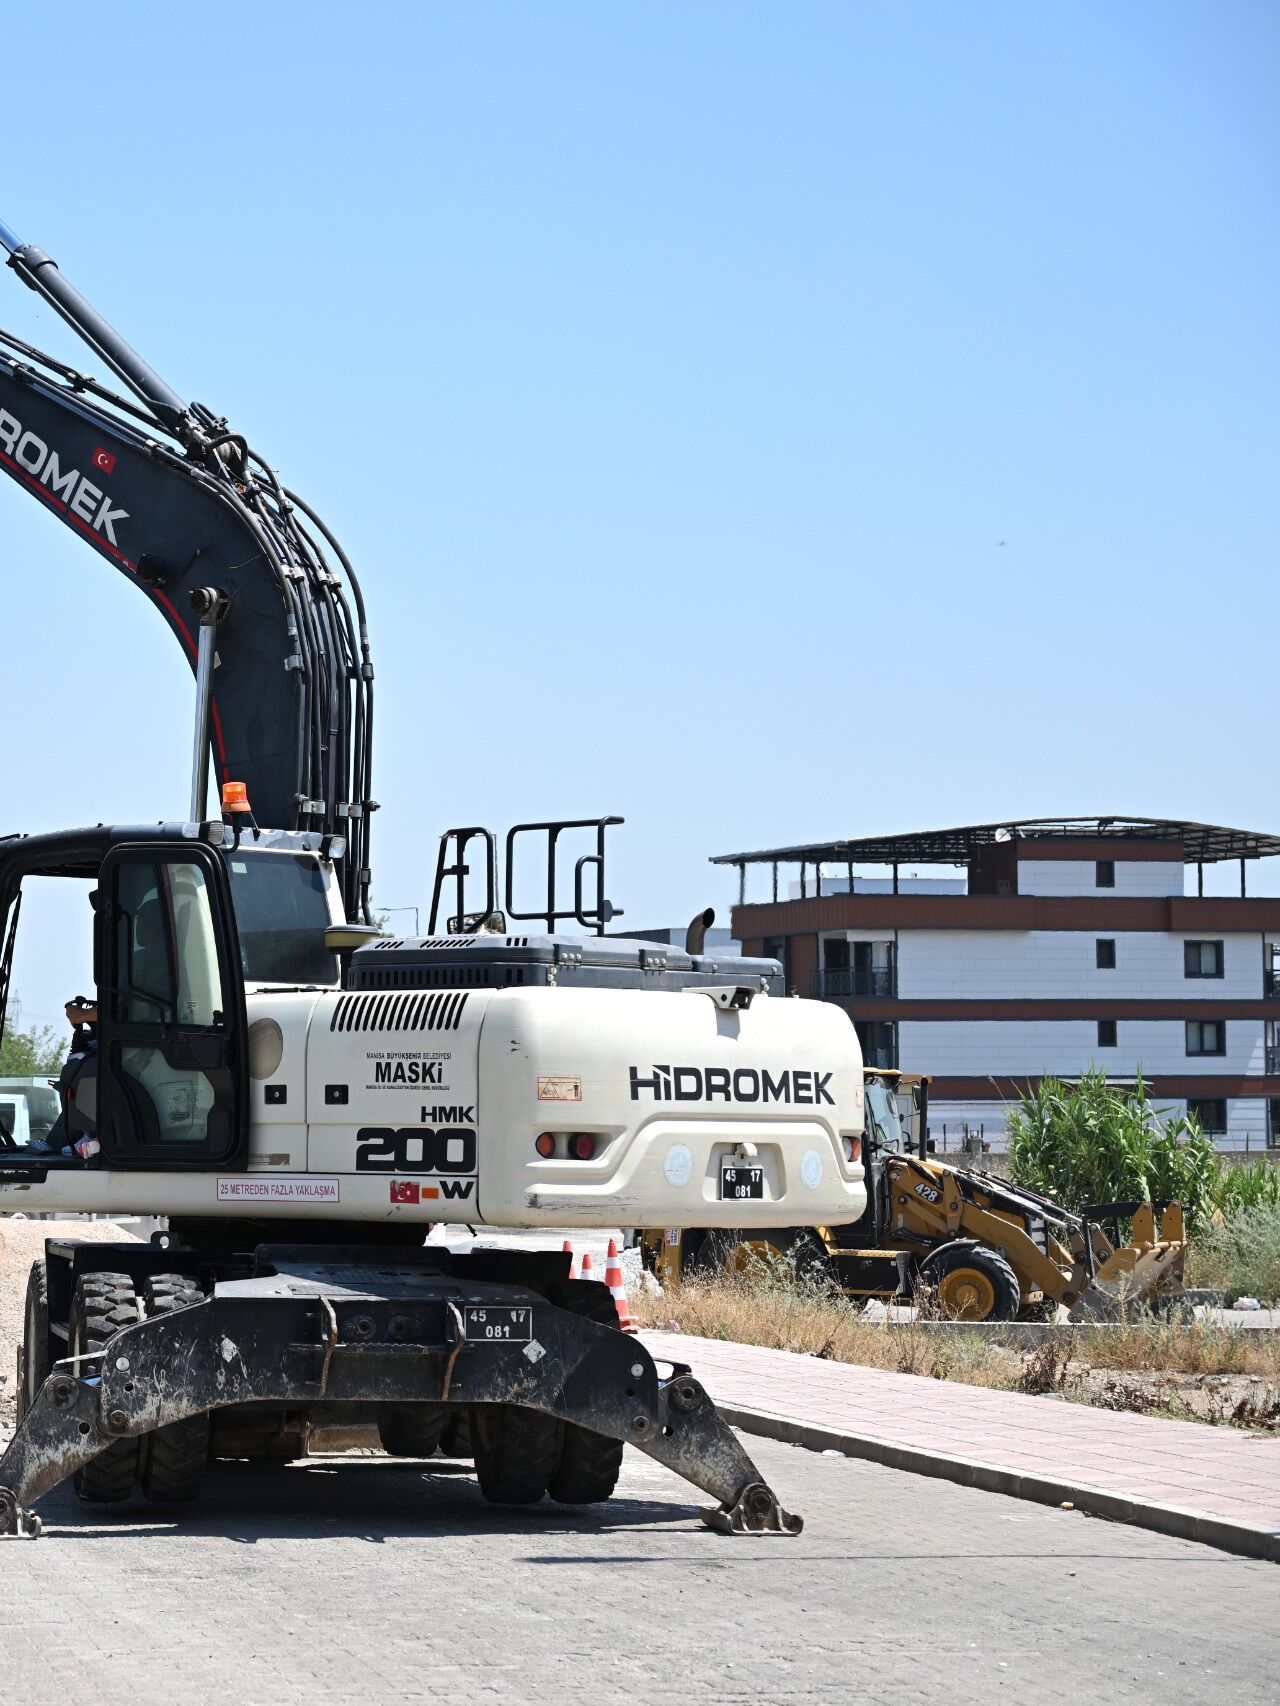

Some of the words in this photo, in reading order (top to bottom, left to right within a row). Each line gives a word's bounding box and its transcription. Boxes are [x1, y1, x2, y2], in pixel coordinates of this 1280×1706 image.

[421, 1105, 475, 1123] HMK
[355, 1127, 476, 1173] 200
[725, 1169, 736, 1182] 45
[750, 1169, 761, 1182] 17
[220, 1184, 229, 1195] 25
[230, 1184, 269, 1196] METREDEN
[270, 1185, 294, 1196] FAZLA
[295, 1185, 336, 1199] YAKLAŞMA
[439, 1180, 474, 1200] W
[735, 1184, 751, 1198] 081
[914, 1183, 938, 1202] 428
[470, 1309, 487, 1323] 45
[510, 1310, 526, 1323] 17
[485, 1325, 510, 1338] 081
